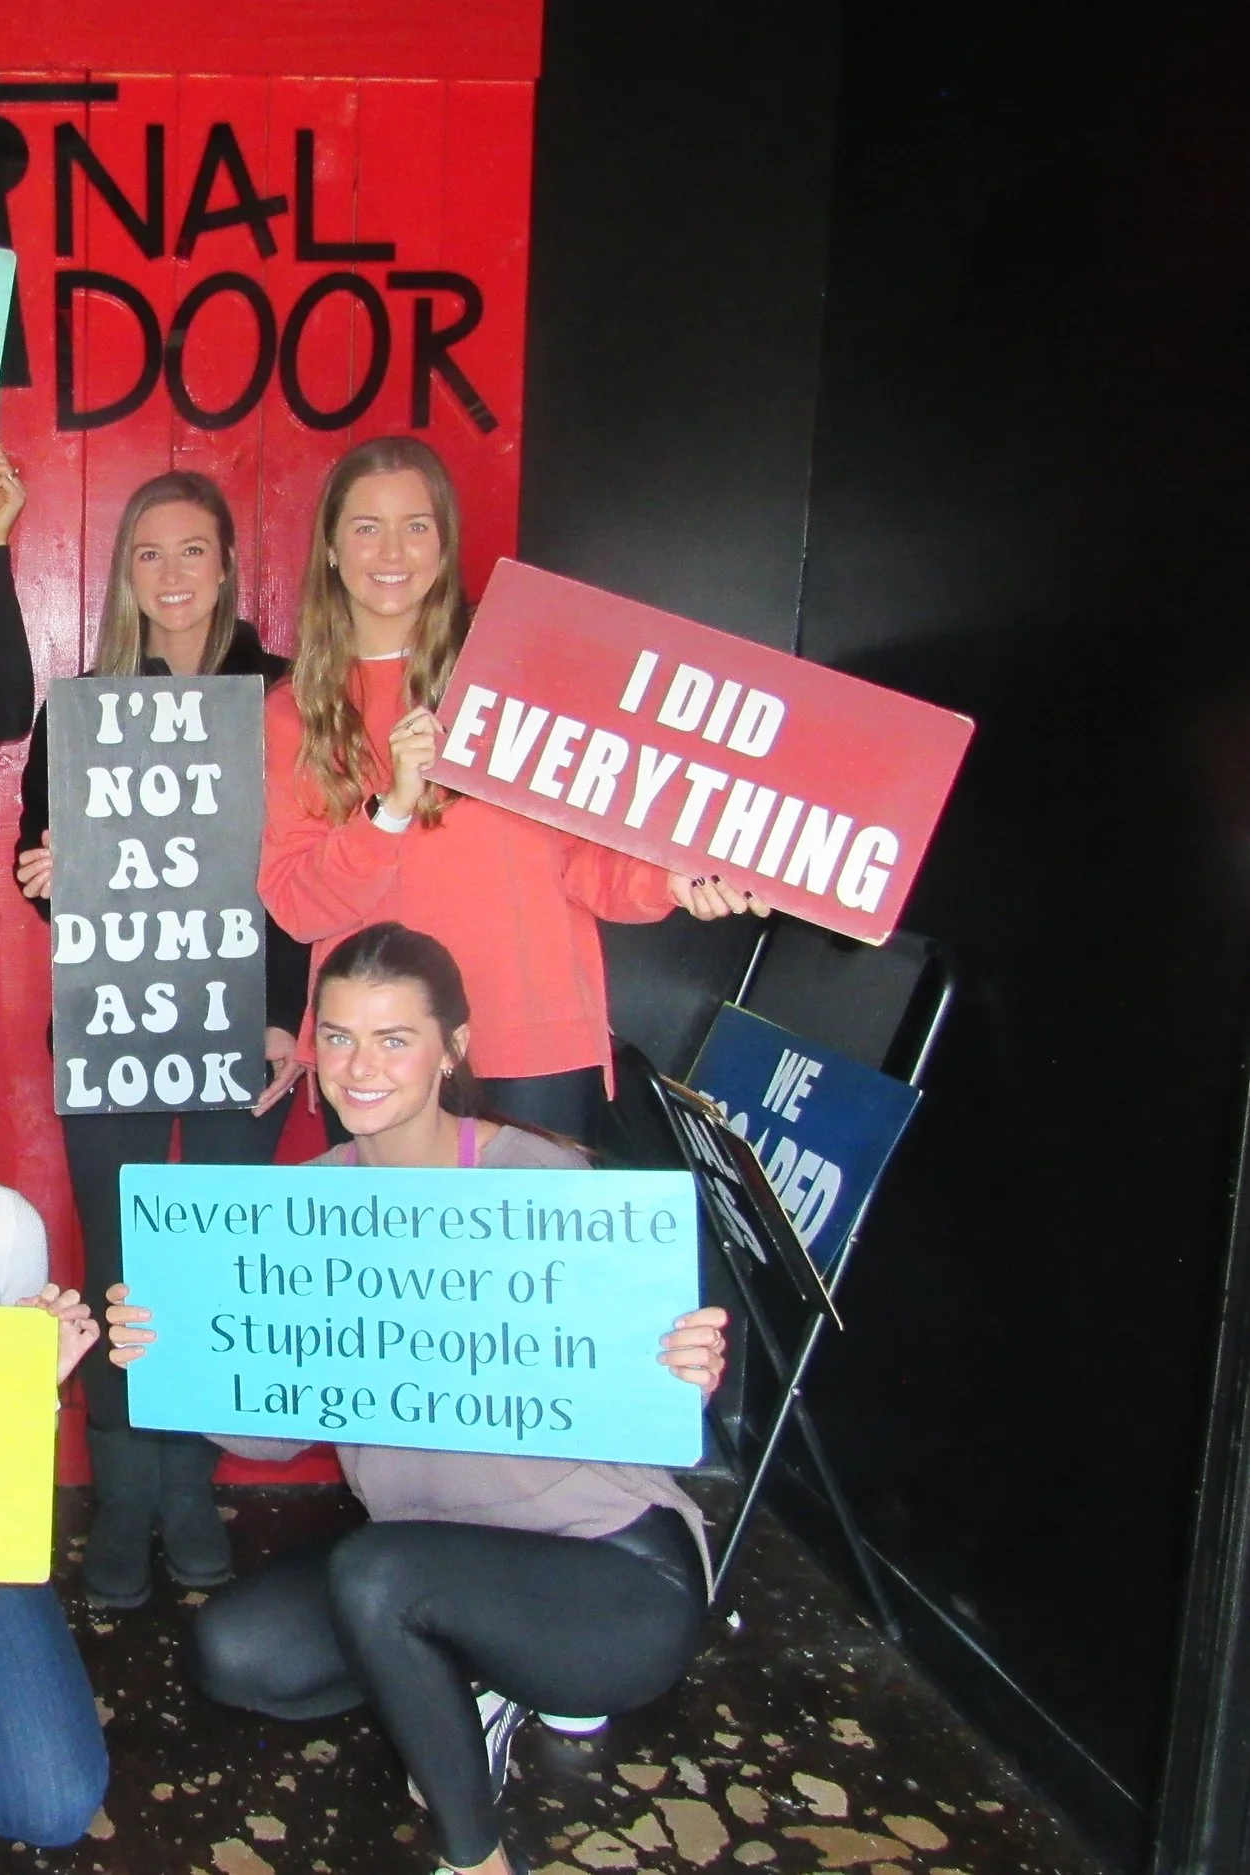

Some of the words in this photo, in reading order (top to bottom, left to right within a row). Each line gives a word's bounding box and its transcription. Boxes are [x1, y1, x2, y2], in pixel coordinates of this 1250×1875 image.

[55, 270, 497, 435] DOOR
[96, 691, 208, 744] I'M
[618, 650, 659, 713] I
[657, 663, 786, 759] DID
[85, 763, 222, 818] NOT
[441, 684, 900, 914] EVERYTHING
[108, 836, 199, 890] AS
[53, 908, 259, 964] DUMB
[85, 982, 178, 1036] AS
[203, 981, 230, 1031] I
[66, 1052, 251, 1108] LOOK
[762, 1048, 823, 1123] WE
[133, 1195, 273, 1236] Never
[286, 1195, 678, 1245] Underestimate
[233, 1254, 313, 1297] the
[326, 1257, 493, 1303] Power
[508, 1260, 566, 1305] of
[210, 1313, 365, 1367] Stupid
[378, 1319, 540, 1376] People
[555, 1327, 596, 1369] in
[233, 1373, 376, 1429] Large
[391, 1381, 573, 1441] Groups
